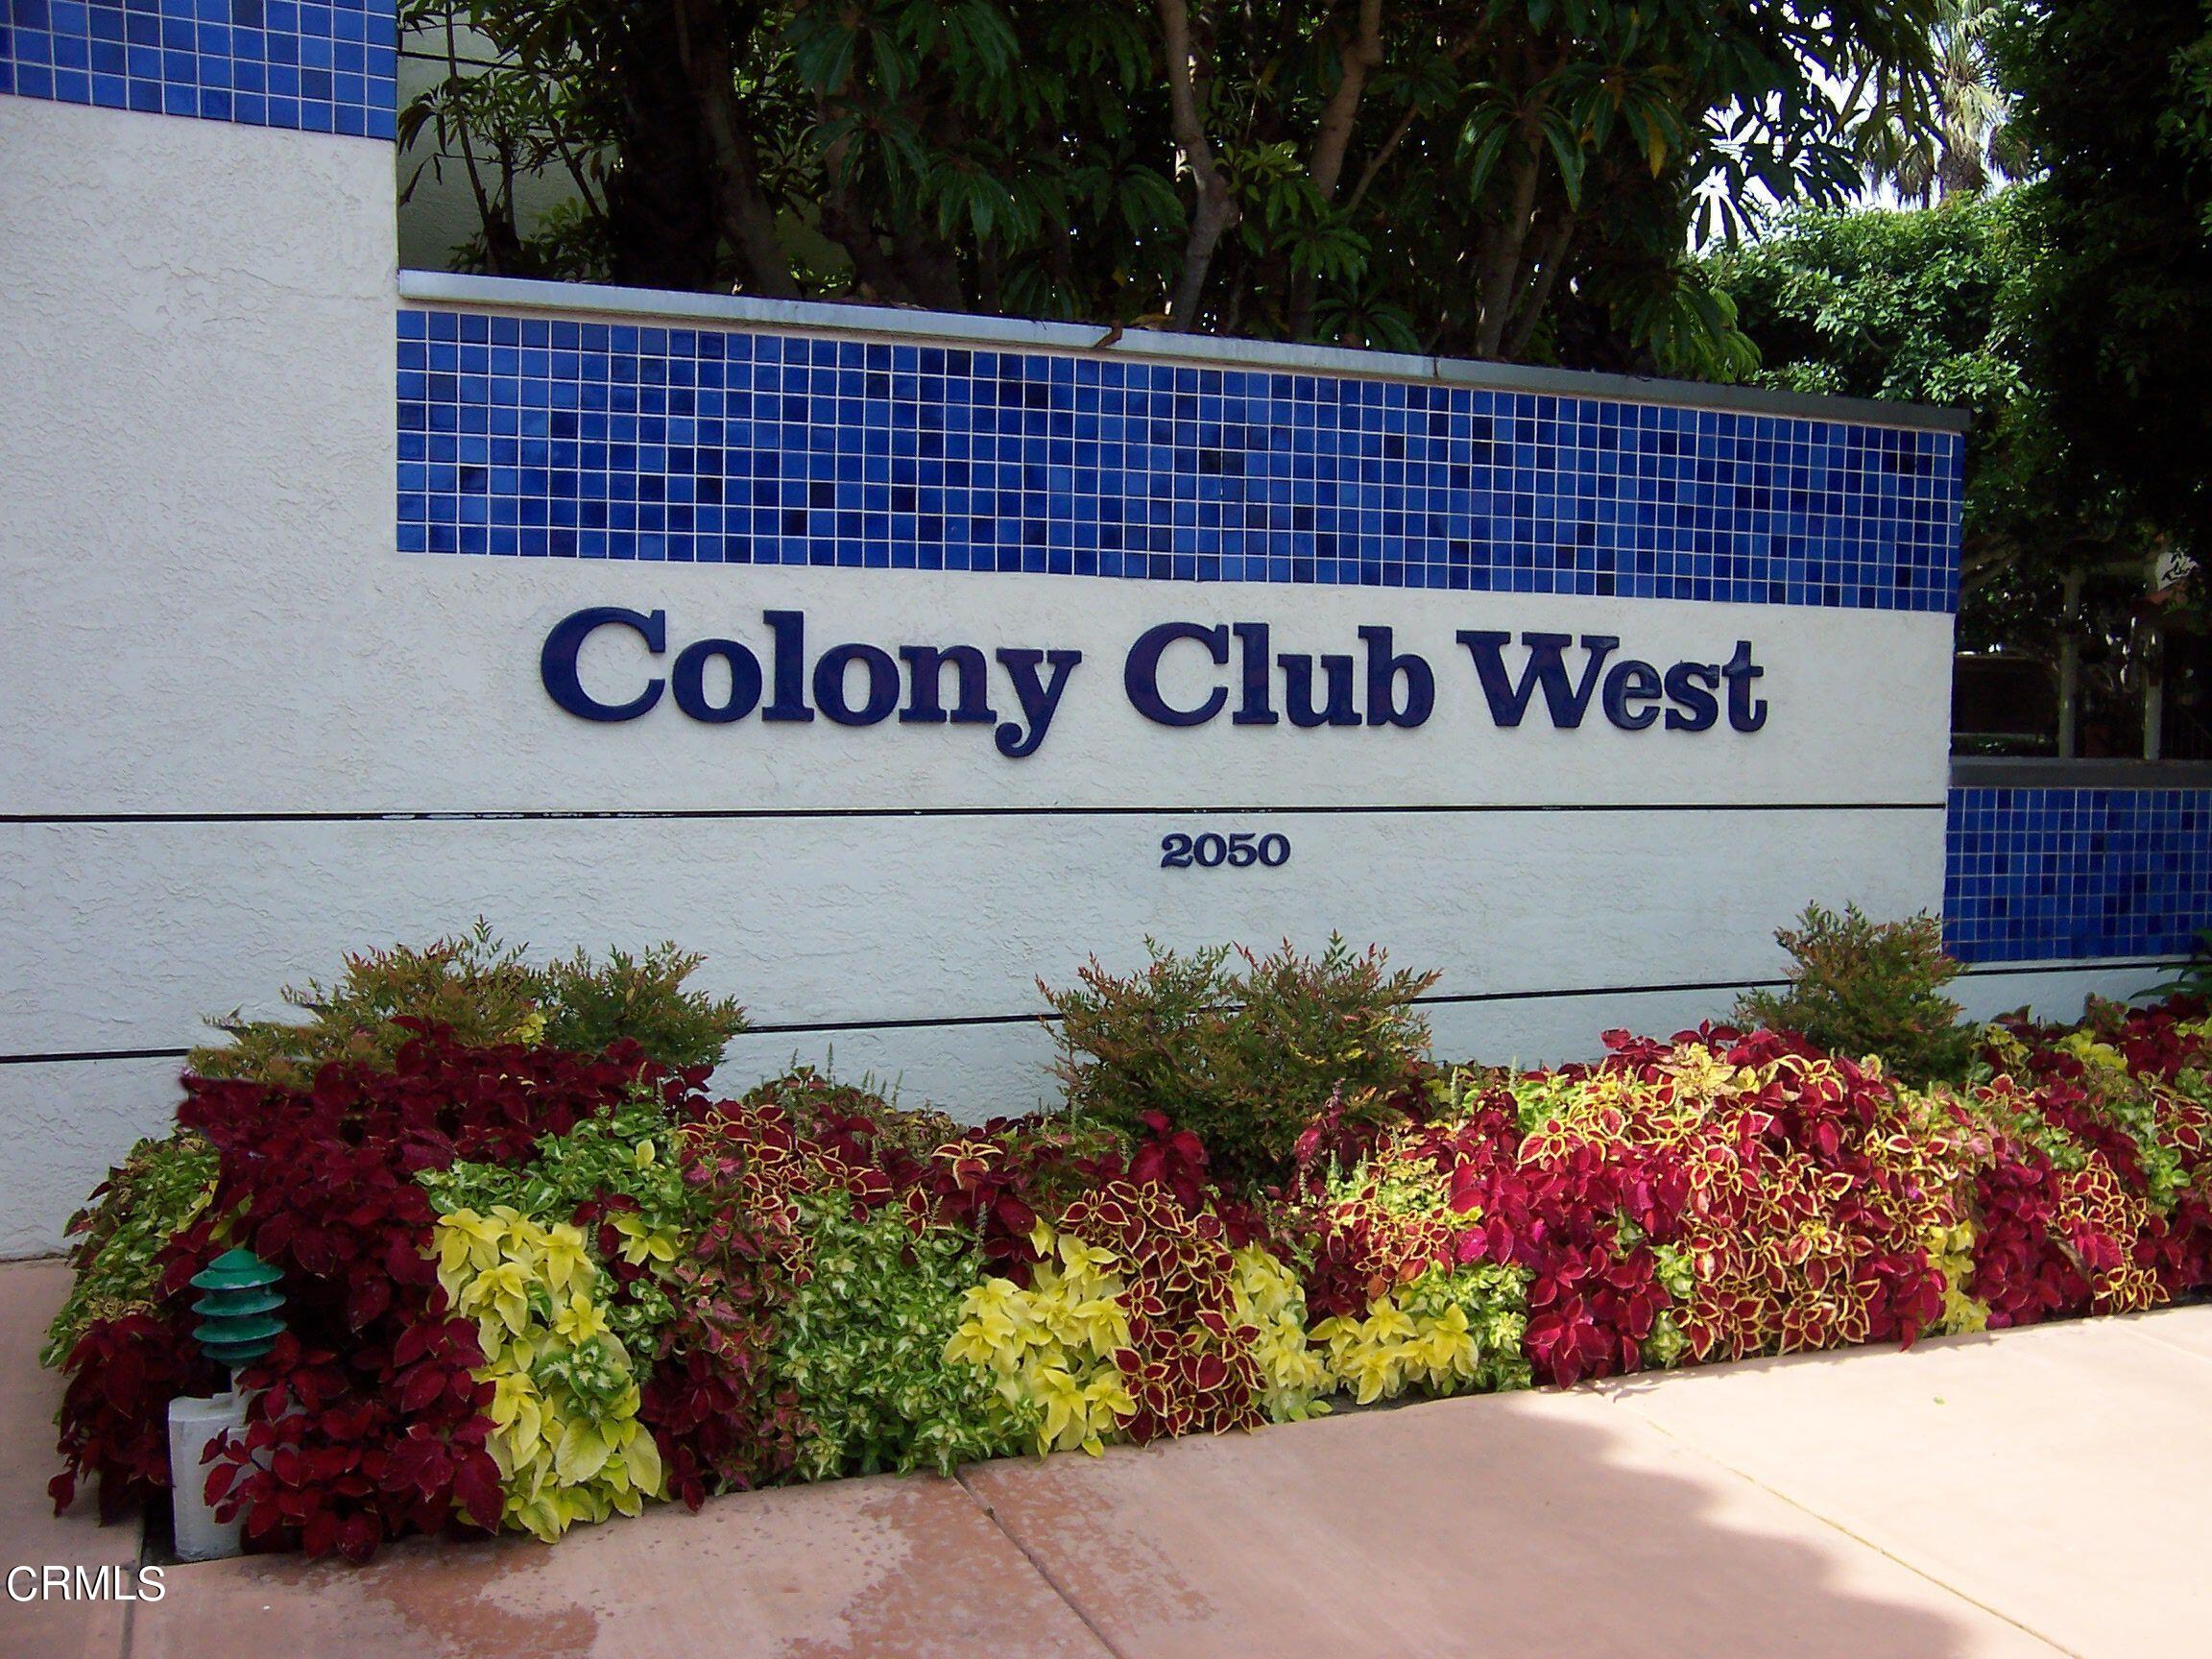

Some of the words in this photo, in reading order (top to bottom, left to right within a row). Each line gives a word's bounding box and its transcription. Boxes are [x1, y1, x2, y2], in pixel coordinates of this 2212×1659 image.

[540, 607, 1083, 760] Colony
[1123, 621, 1435, 731] Club
[1455, 629, 1768, 734] West
[1160, 832, 1291, 870] 2050
